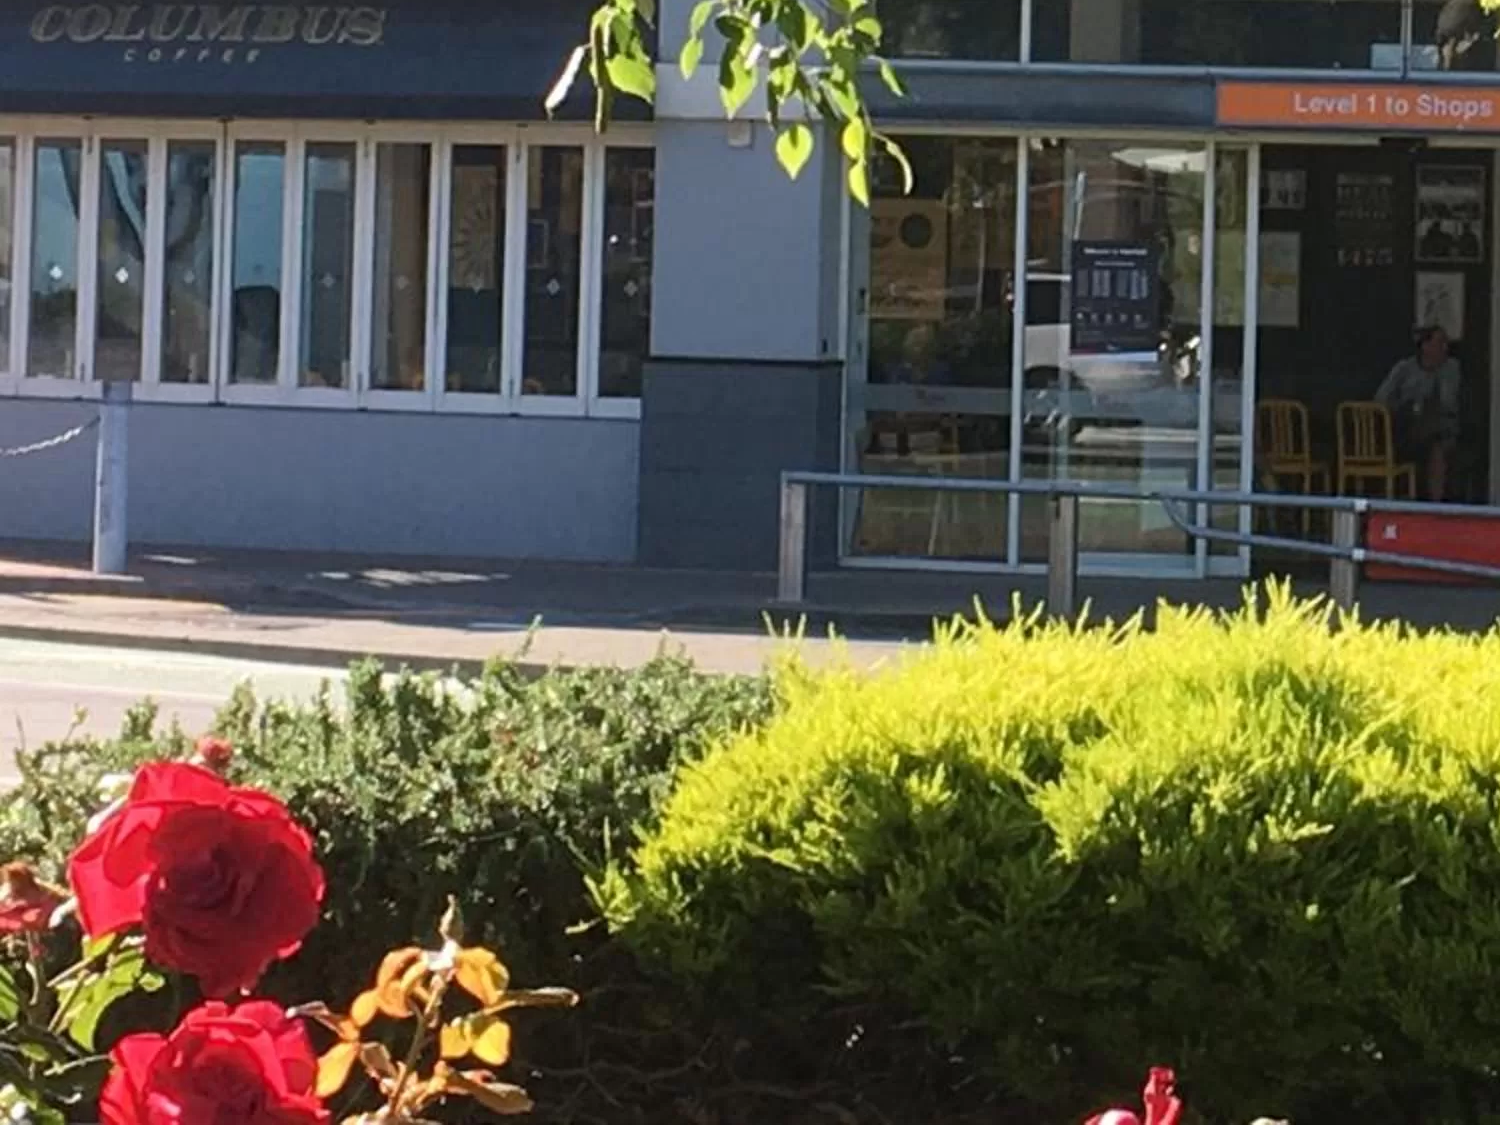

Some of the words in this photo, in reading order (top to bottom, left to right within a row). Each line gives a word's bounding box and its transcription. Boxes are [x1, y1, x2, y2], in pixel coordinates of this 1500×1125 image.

[30, 4, 385, 45] COLUMBUS
[123, 48, 260, 63] COFFEE
[1294, 92, 1357, 114] Level
[1366, 93, 1376, 114] 1
[1385, 95, 1410, 116] to
[1416, 93, 1493, 120] Shops
